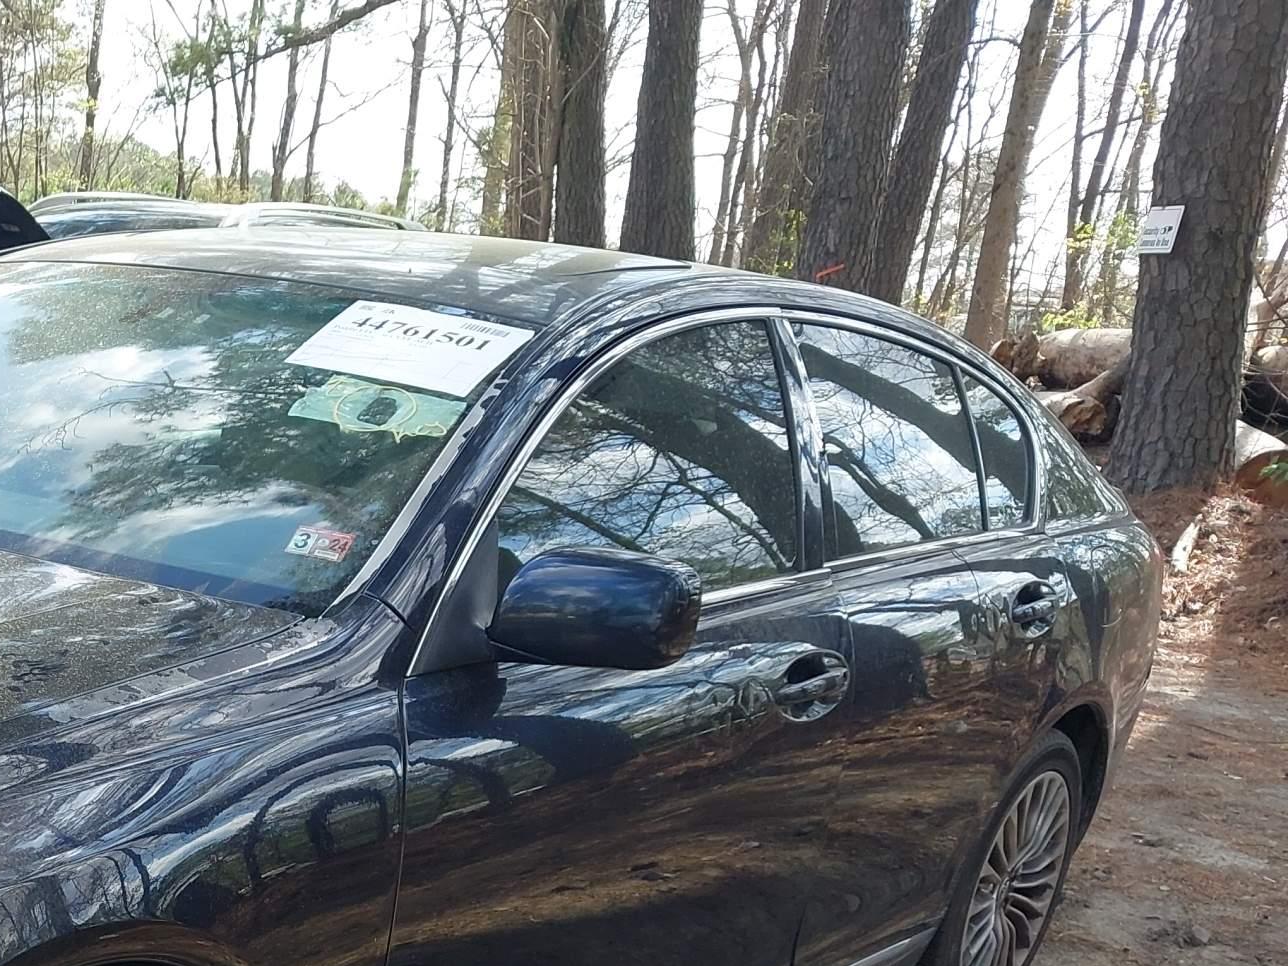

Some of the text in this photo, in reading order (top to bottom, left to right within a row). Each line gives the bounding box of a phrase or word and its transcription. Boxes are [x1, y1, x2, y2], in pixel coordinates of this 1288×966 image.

[351, 316, 492, 351] 44761501
[294, 532, 349, 553] 3 24
